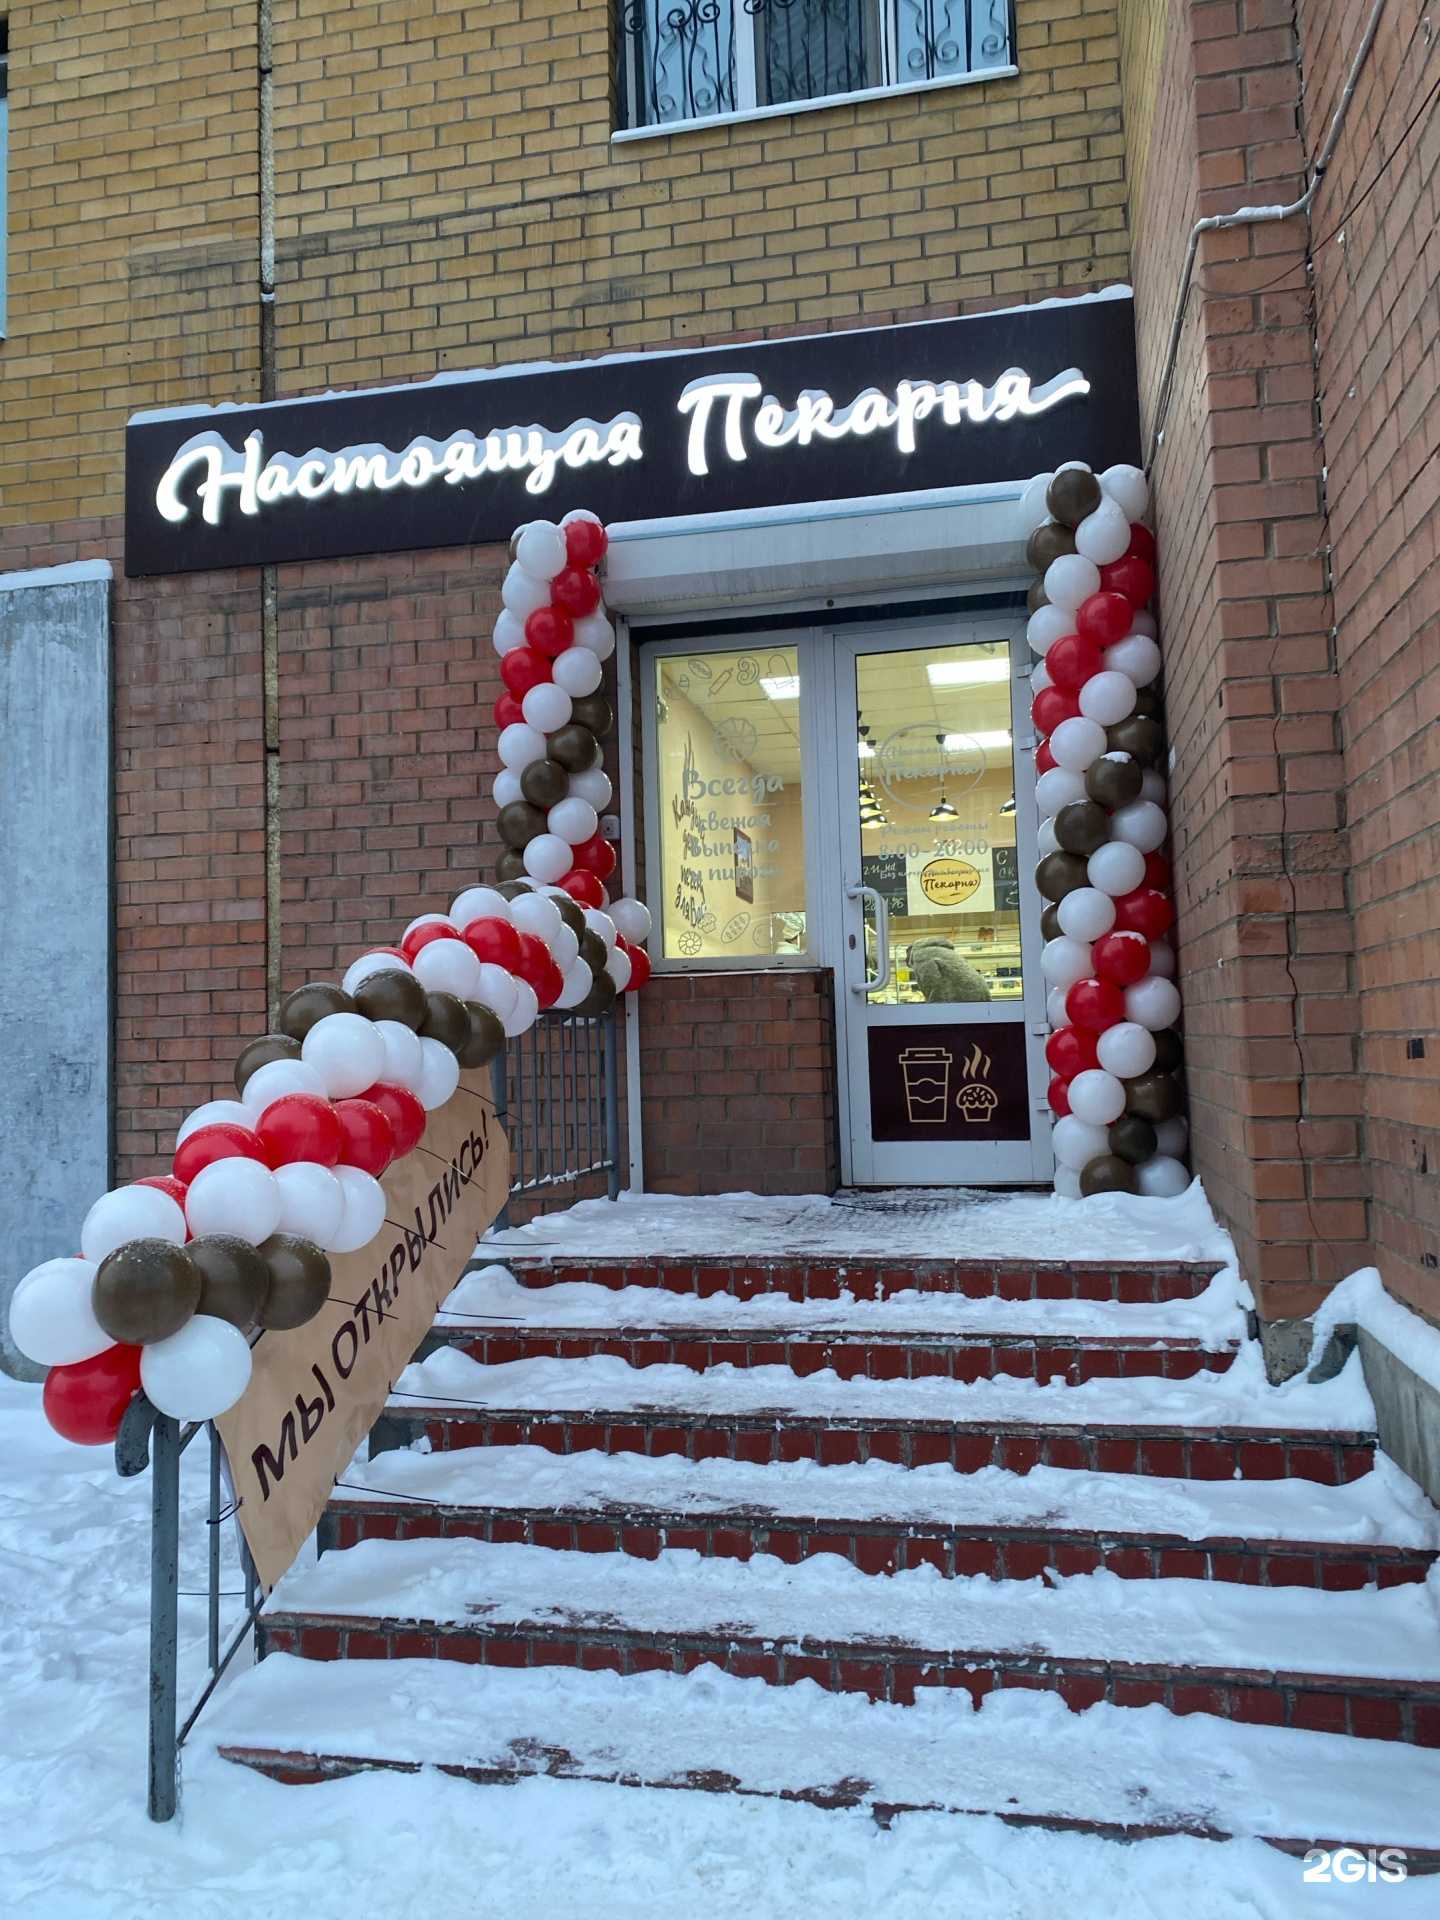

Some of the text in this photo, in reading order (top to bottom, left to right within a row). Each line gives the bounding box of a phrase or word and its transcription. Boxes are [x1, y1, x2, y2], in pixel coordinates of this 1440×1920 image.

[155, 370, 1090, 526] Настоящая Пекарня
[682, 767, 785, 805] Всегда
[923, 878, 978, 893] Пекарня
[251, 1108, 491, 1502] МЫ ОТКРЫЛИСЬ!
